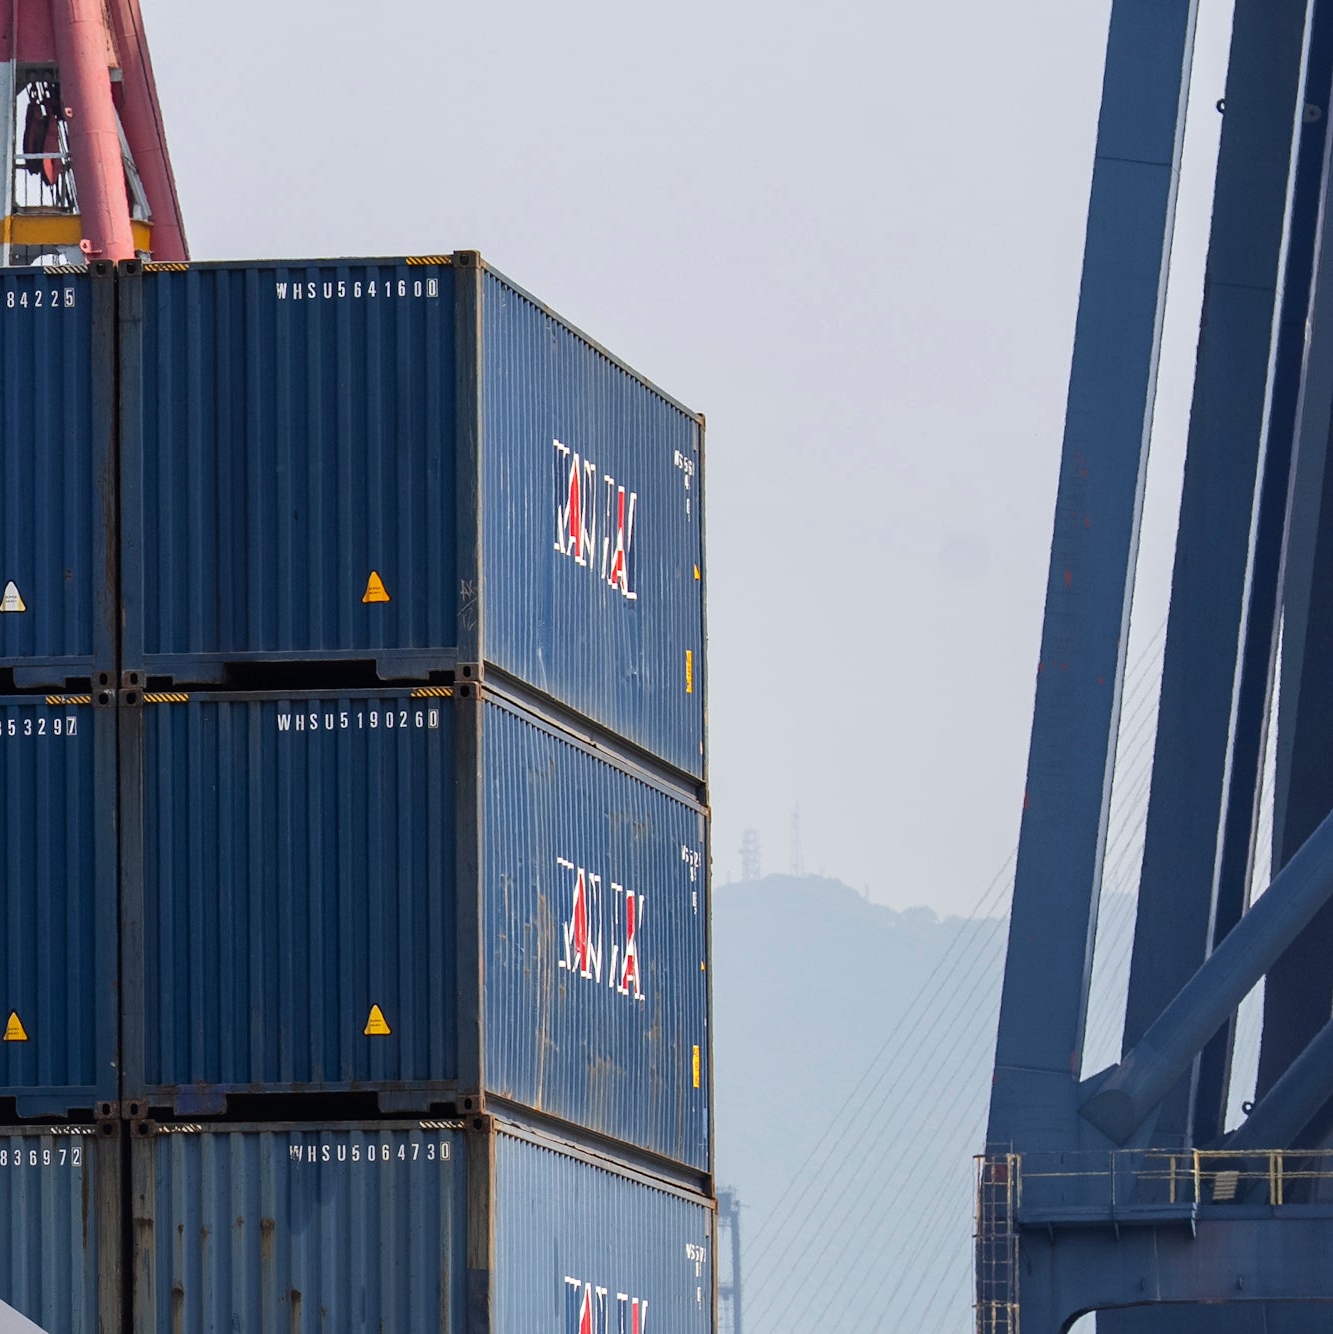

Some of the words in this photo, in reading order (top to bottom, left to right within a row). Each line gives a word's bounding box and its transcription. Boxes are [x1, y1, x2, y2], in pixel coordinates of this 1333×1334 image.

[277, 279, 438, 299] WHSU5641600
[278, 710, 438, 730] WHSU5190260
[290, 1142, 450, 1161] WHSU5064730
